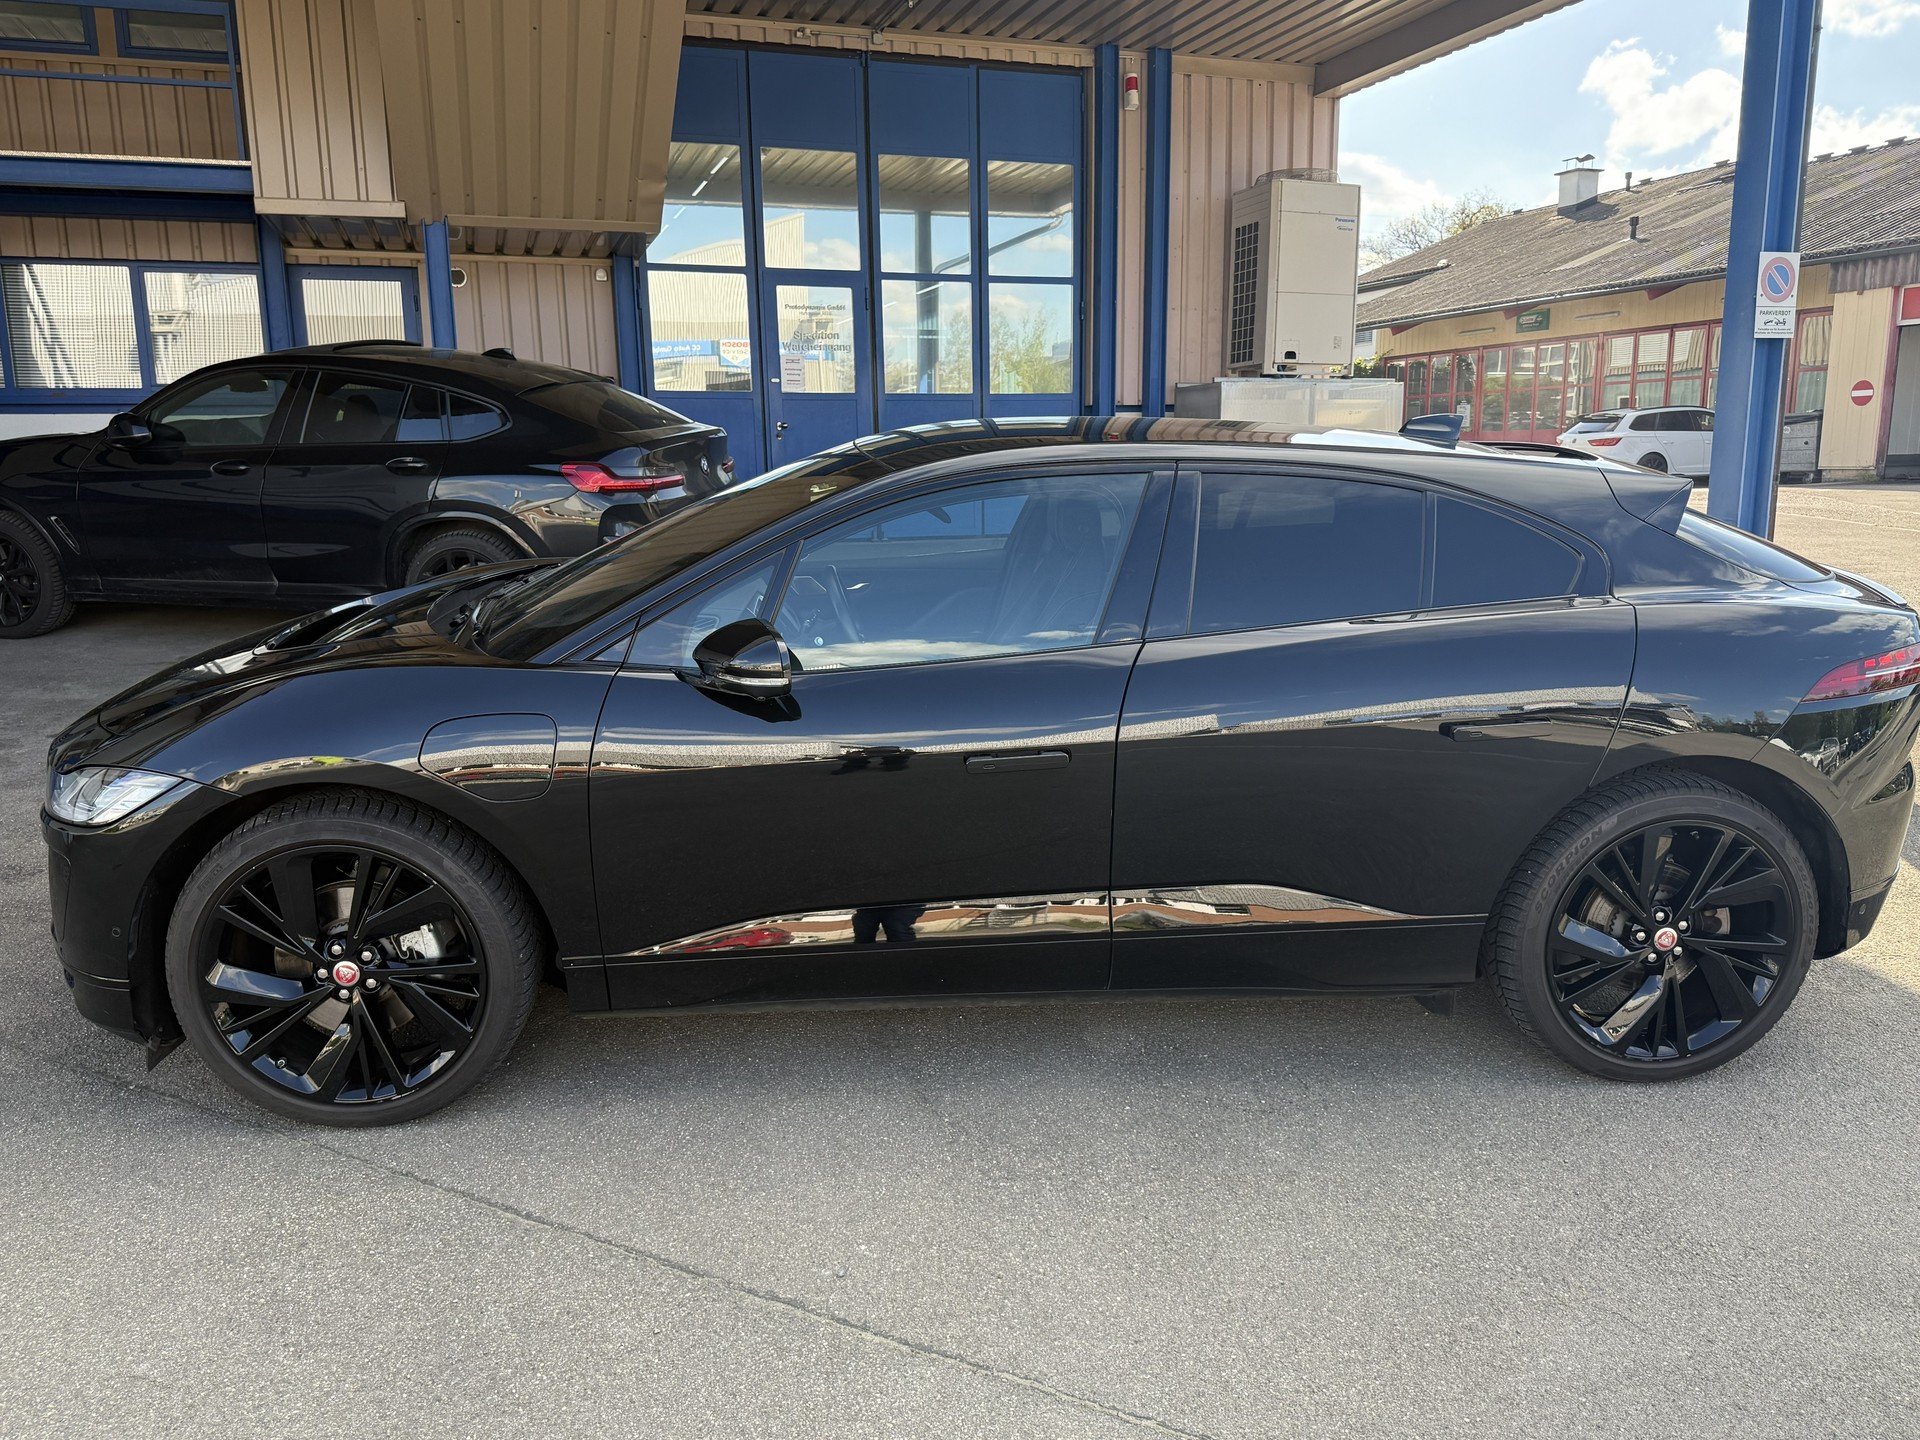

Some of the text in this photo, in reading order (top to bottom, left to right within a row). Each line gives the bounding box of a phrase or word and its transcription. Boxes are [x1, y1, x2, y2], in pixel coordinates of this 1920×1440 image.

[793, 331, 840, 341] Spedition
[782, 341, 852, 353] Wareneingang
[1535, 824, 1604, 914] SCORPION
